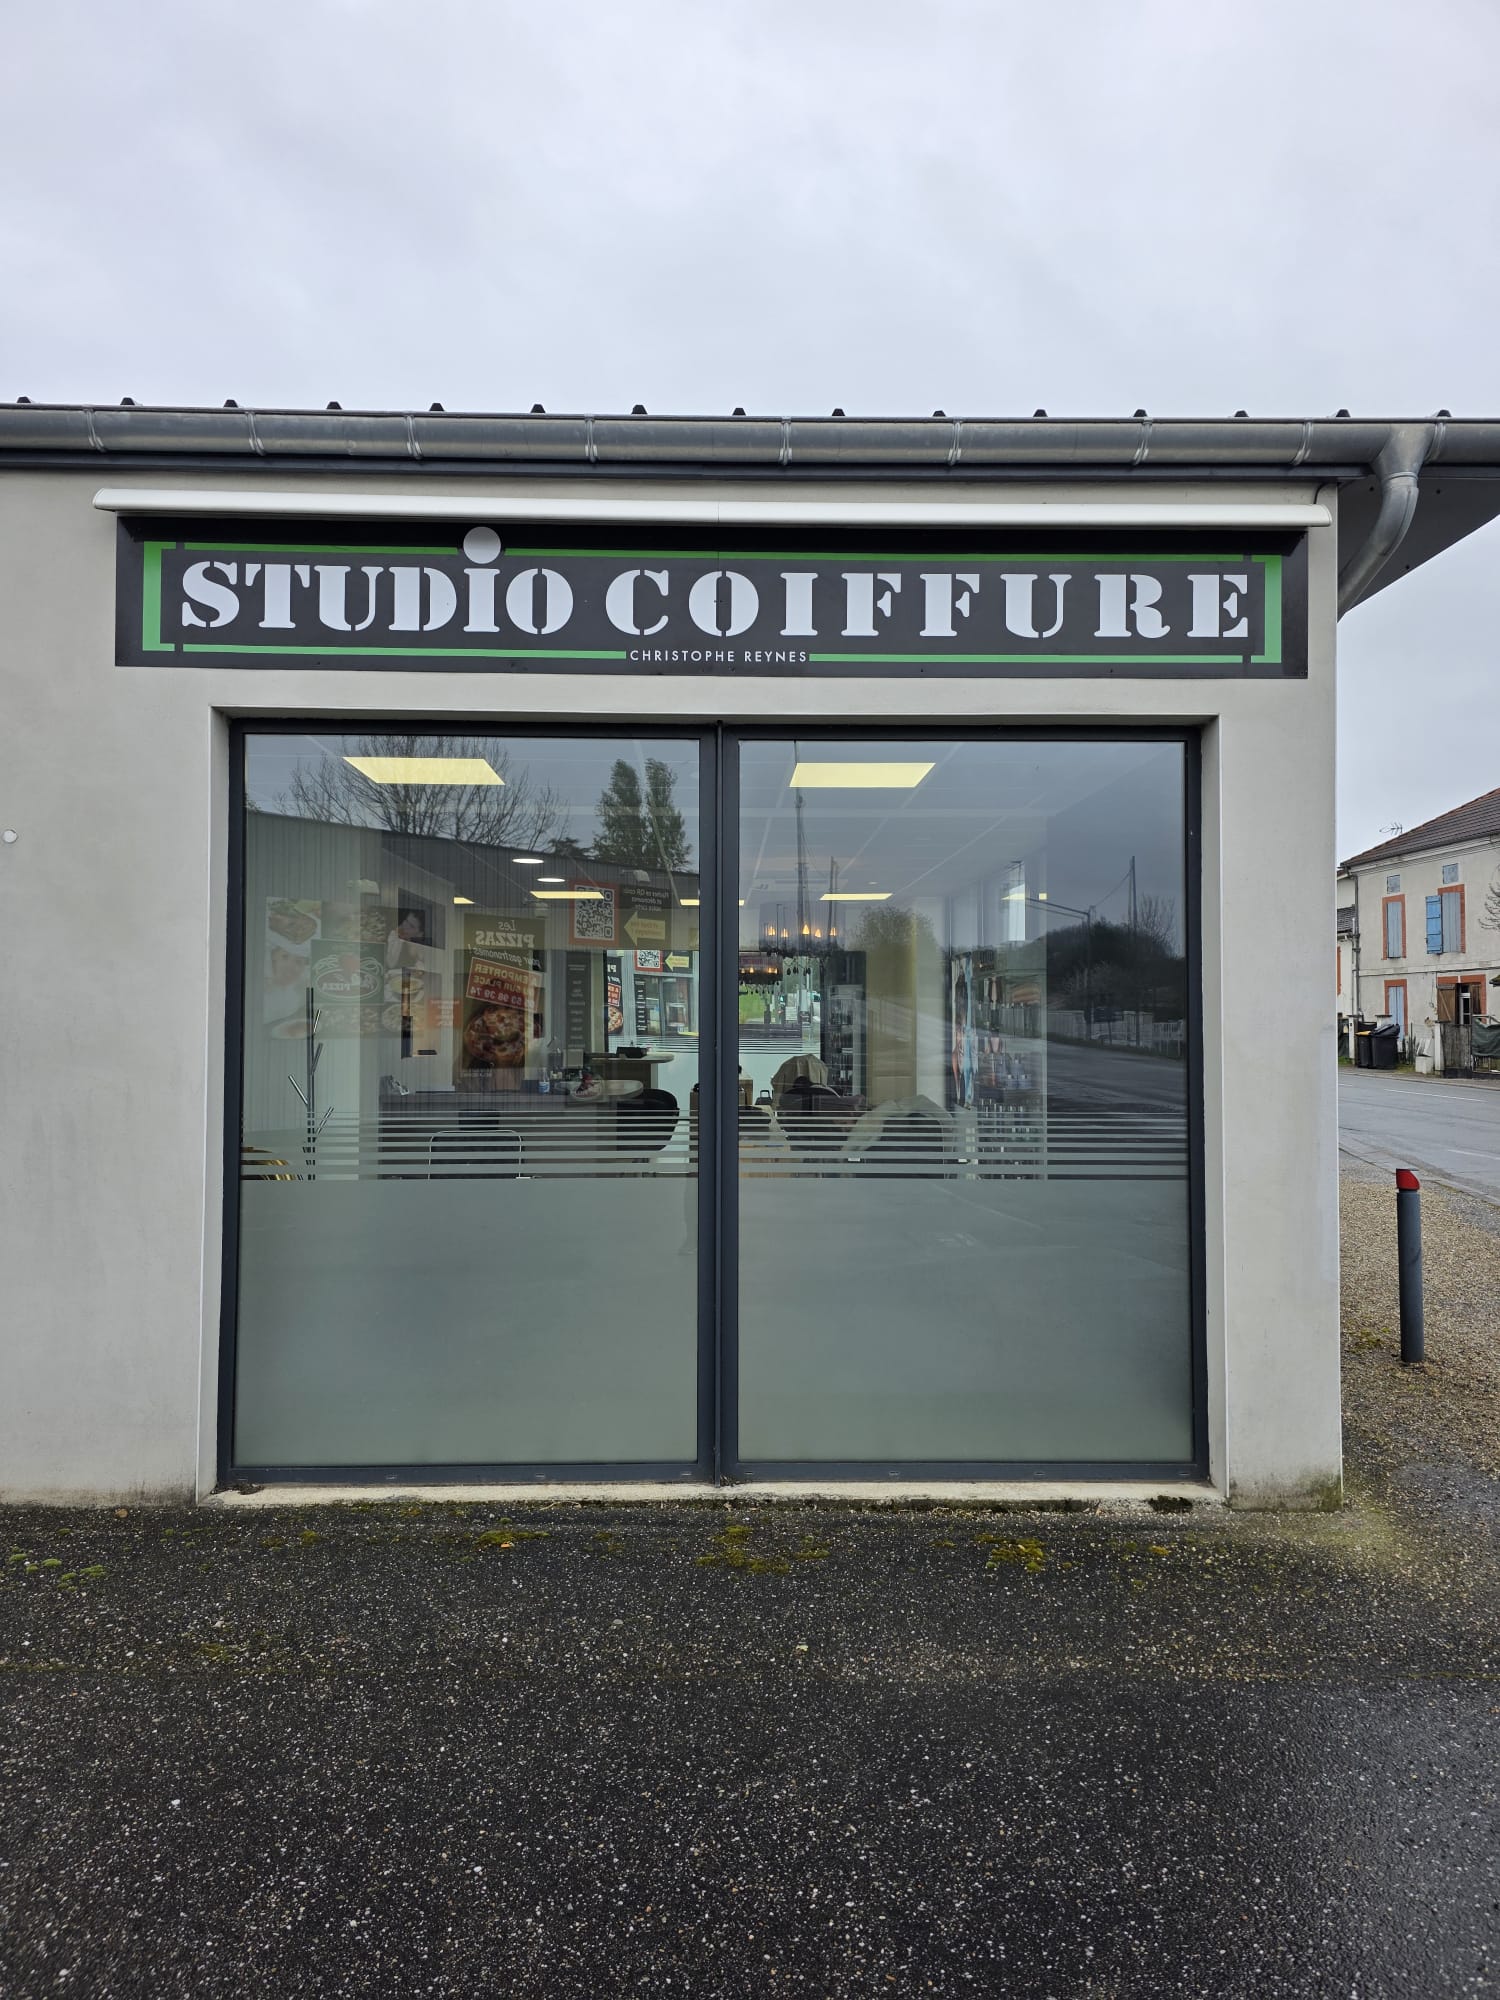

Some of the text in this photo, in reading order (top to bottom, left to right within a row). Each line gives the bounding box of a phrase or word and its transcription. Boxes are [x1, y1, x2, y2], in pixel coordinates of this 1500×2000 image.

[605, 569, 1249, 638] COIFFURE
[629, 650, 807, 662] CHRISTOPHE REYNES
